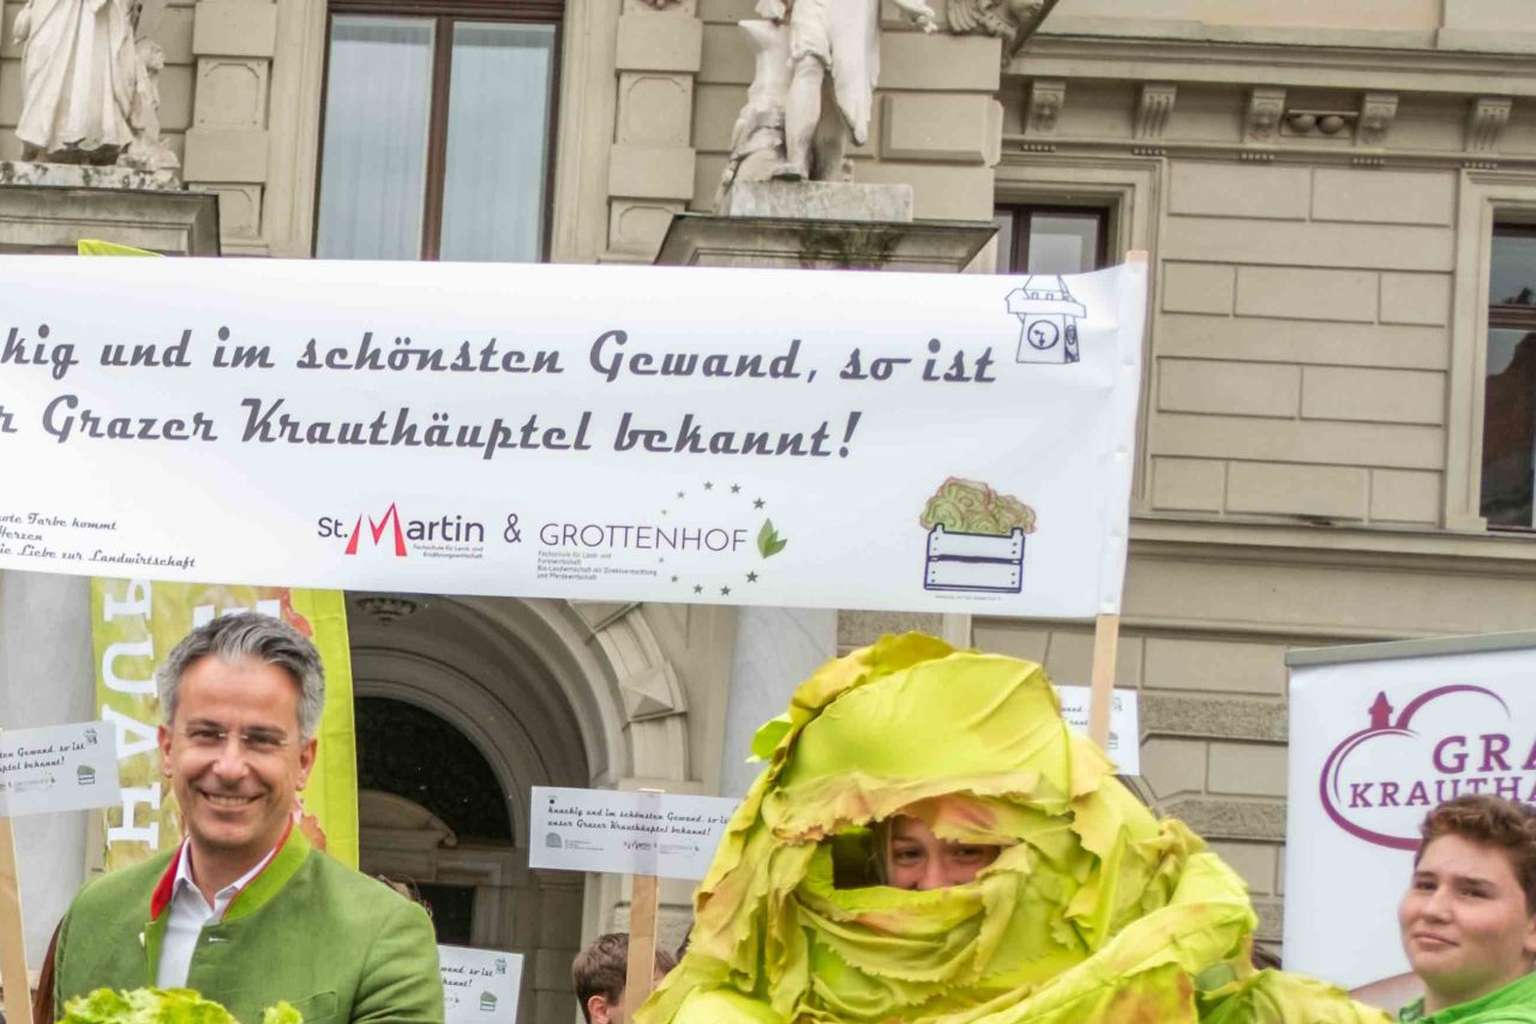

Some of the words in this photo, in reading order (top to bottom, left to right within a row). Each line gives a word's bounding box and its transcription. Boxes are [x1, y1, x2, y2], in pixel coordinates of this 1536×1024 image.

[100, 327, 192, 369] und
[212, 326, 275, 369] im
[297, 331, 565, 373] schönsten
[589, 329, 817, 384] Gewand,
[840, 346, 912, 383] so
[922, 338, 997, 385] ist
[42, 394, 219, 445] Grazer
[241, 398, 592, 460] Krauthäuptel
[613, 411, 862, 458] bekannt!
[28, 513, 66, 527] Farbe
[72, 518, 117, 530] kommt
[502, 513, 522, 545] &
[539, 523, 748, 552] GROTTENHOF
[17, 544, 56, 558] Liebe
[61, 552, 83, 560] zur
[88, 550, 196, 569] Landwirtschaft
[1349, 776, 1536, 809] KRAUTH
